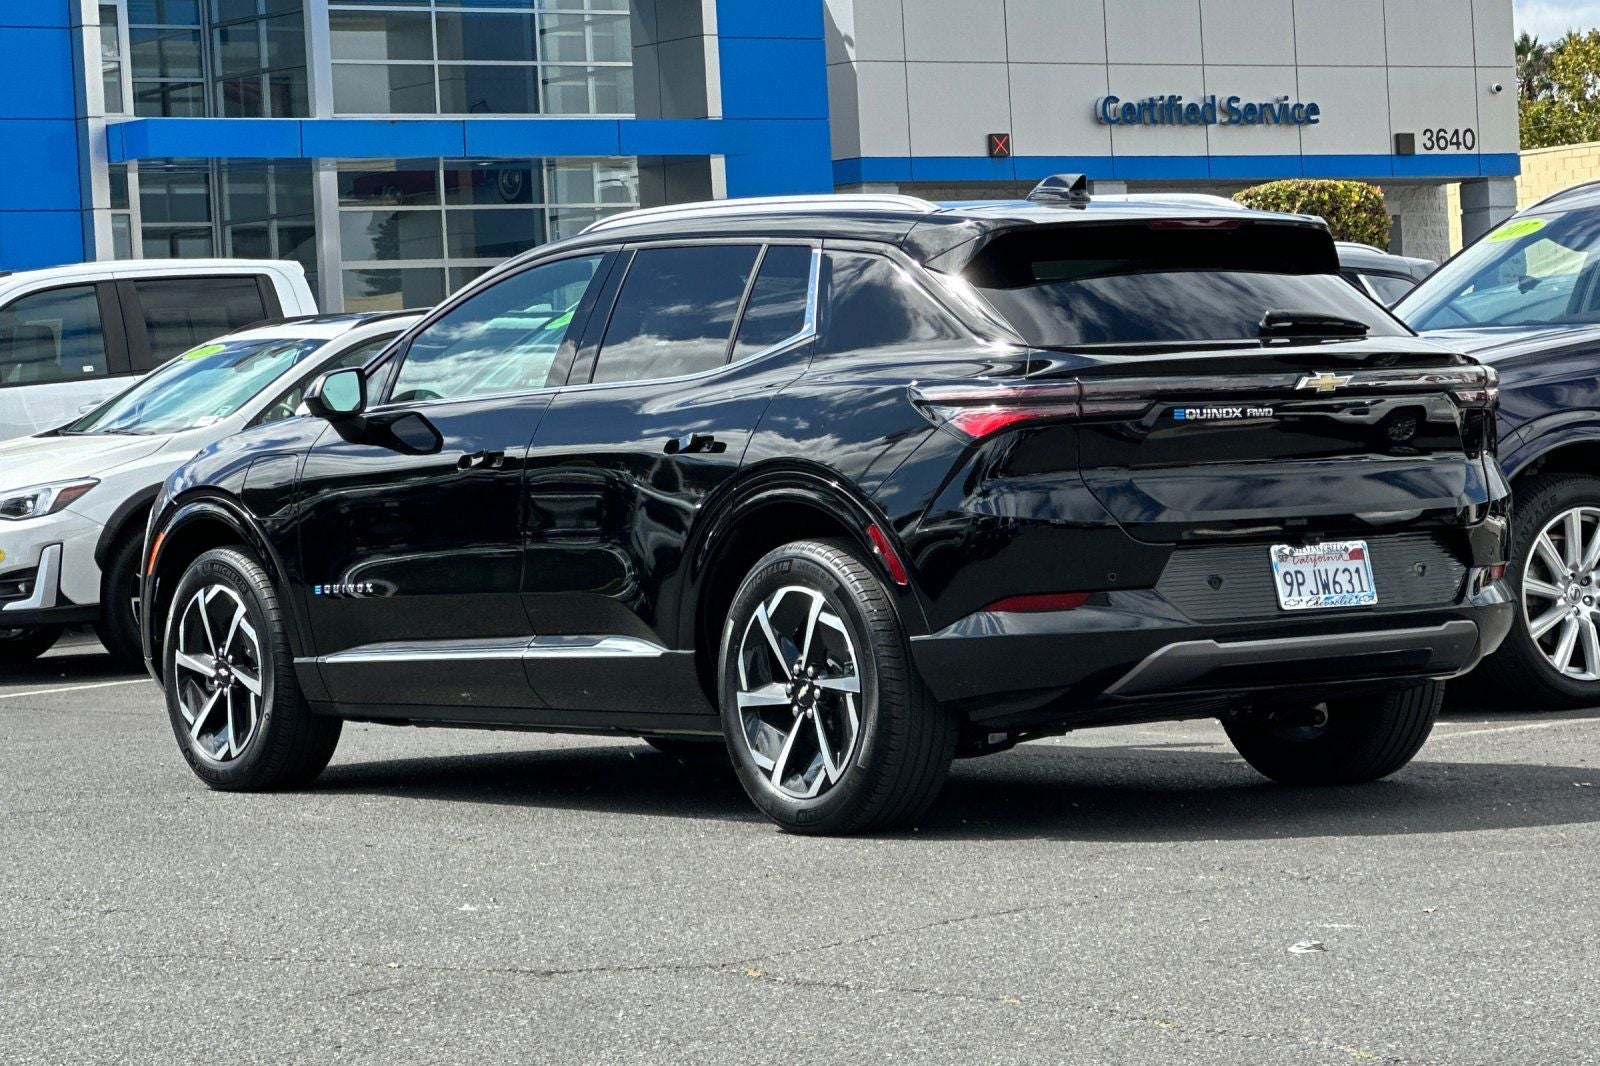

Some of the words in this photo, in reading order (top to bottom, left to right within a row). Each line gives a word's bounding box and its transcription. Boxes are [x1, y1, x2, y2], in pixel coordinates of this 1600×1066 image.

[1096, 95, 1216, 125] Certified
[1222, 95, 1320, 125] Service
[1421, 128, 1476, 151] 3640
[1174, 408, 1242, 420] EQUINOX
[1292, 554, 1344, 567] California
[1283, 566, 1367, 598] 9PJW631
[314, 583, 373, 595] EQUINOX
[1306, 596, 1353, 607] Chevrolet
